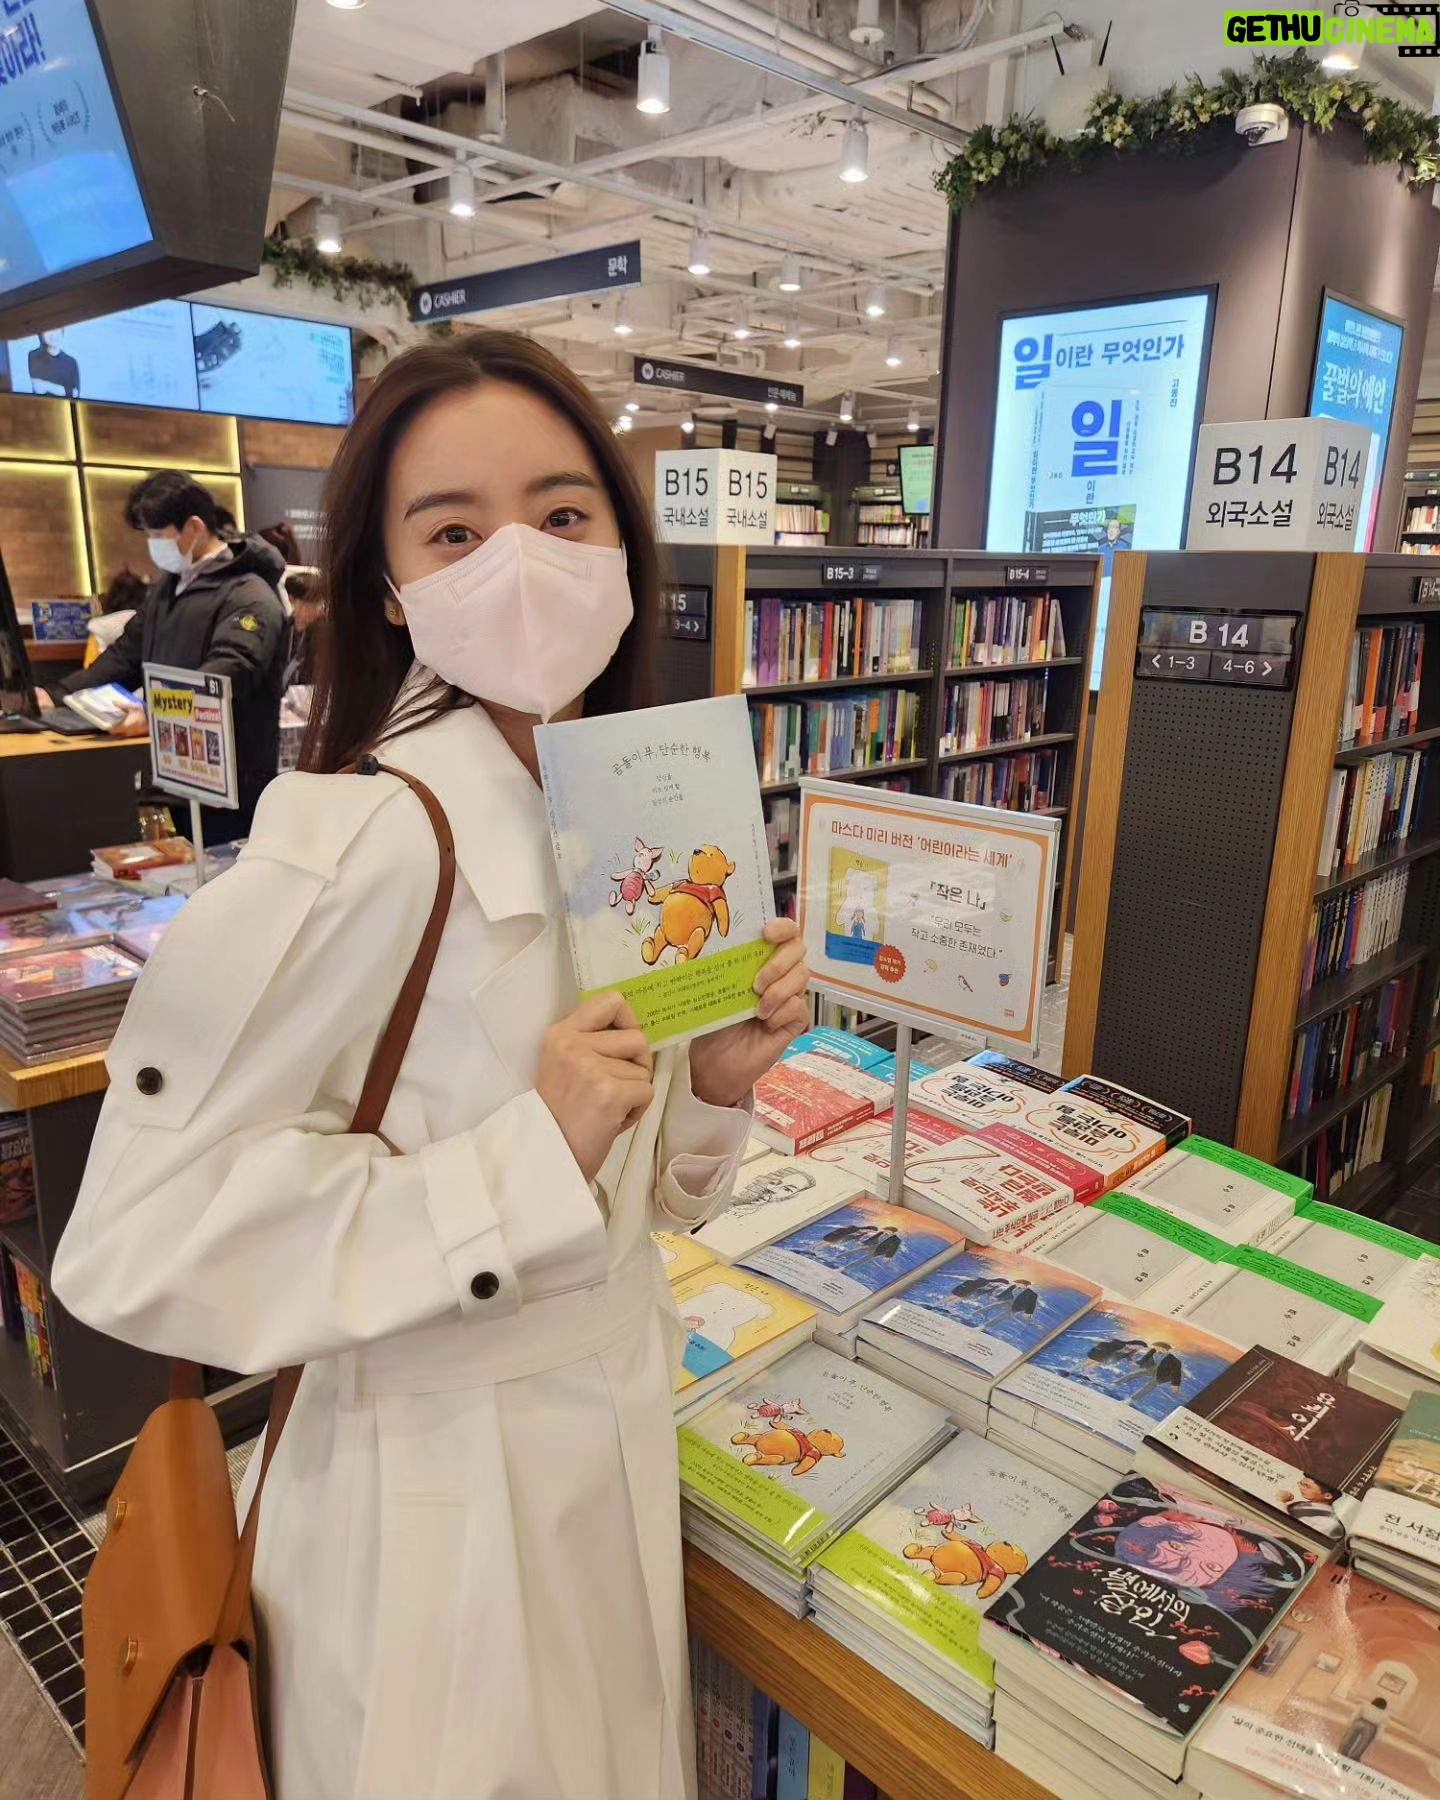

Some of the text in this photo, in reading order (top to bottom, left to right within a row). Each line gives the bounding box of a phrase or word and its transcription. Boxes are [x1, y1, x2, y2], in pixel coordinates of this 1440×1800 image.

[607, 255, 628, 277] 문학
[434, 289, 467, 309] CASHIER
[1101, 334, 1184, 364] 무엇인가
[656, 368, 685, 383] CASHIER
[1071, 400, 1122, 477] 일
[1213, 443, 1298, 485] B14
[1324, 446, 1361, 488] B14
[665, 468, 709, 497] B15
[729, 469, 768, 499] B15
[663, 506, 709, 527] 국내소설
[726, 507, 768, 529] 국내소설
[1206, 499, 1294, 528] 외국소설
[1317, 502, 1354, 531] 외국소설
[827, 567, 854, 580] B15-3
[1009, 567, 1029, 580] B15-4
[1189, 620, 1249, 647] B 14
[1168, 655, 1195, 670] 1-3
[1223, 660, 1255, 674] 4-6
[153, 692, 193, 713] Mystery
[611, 748, 642, 776] 곰돌이
[659, 743, 689, 757] 단순한
[692, 746, 712, 761] 행복
[831, 820, 864, 838] 마스다
[866, 829, 888, 844] 미리
[892, 832, 913, 849] 버전
[911, 929, 929, 941] 작고
[930, 934, 957, 948] 소중한
[954, 921, 983, 937] 모두는
